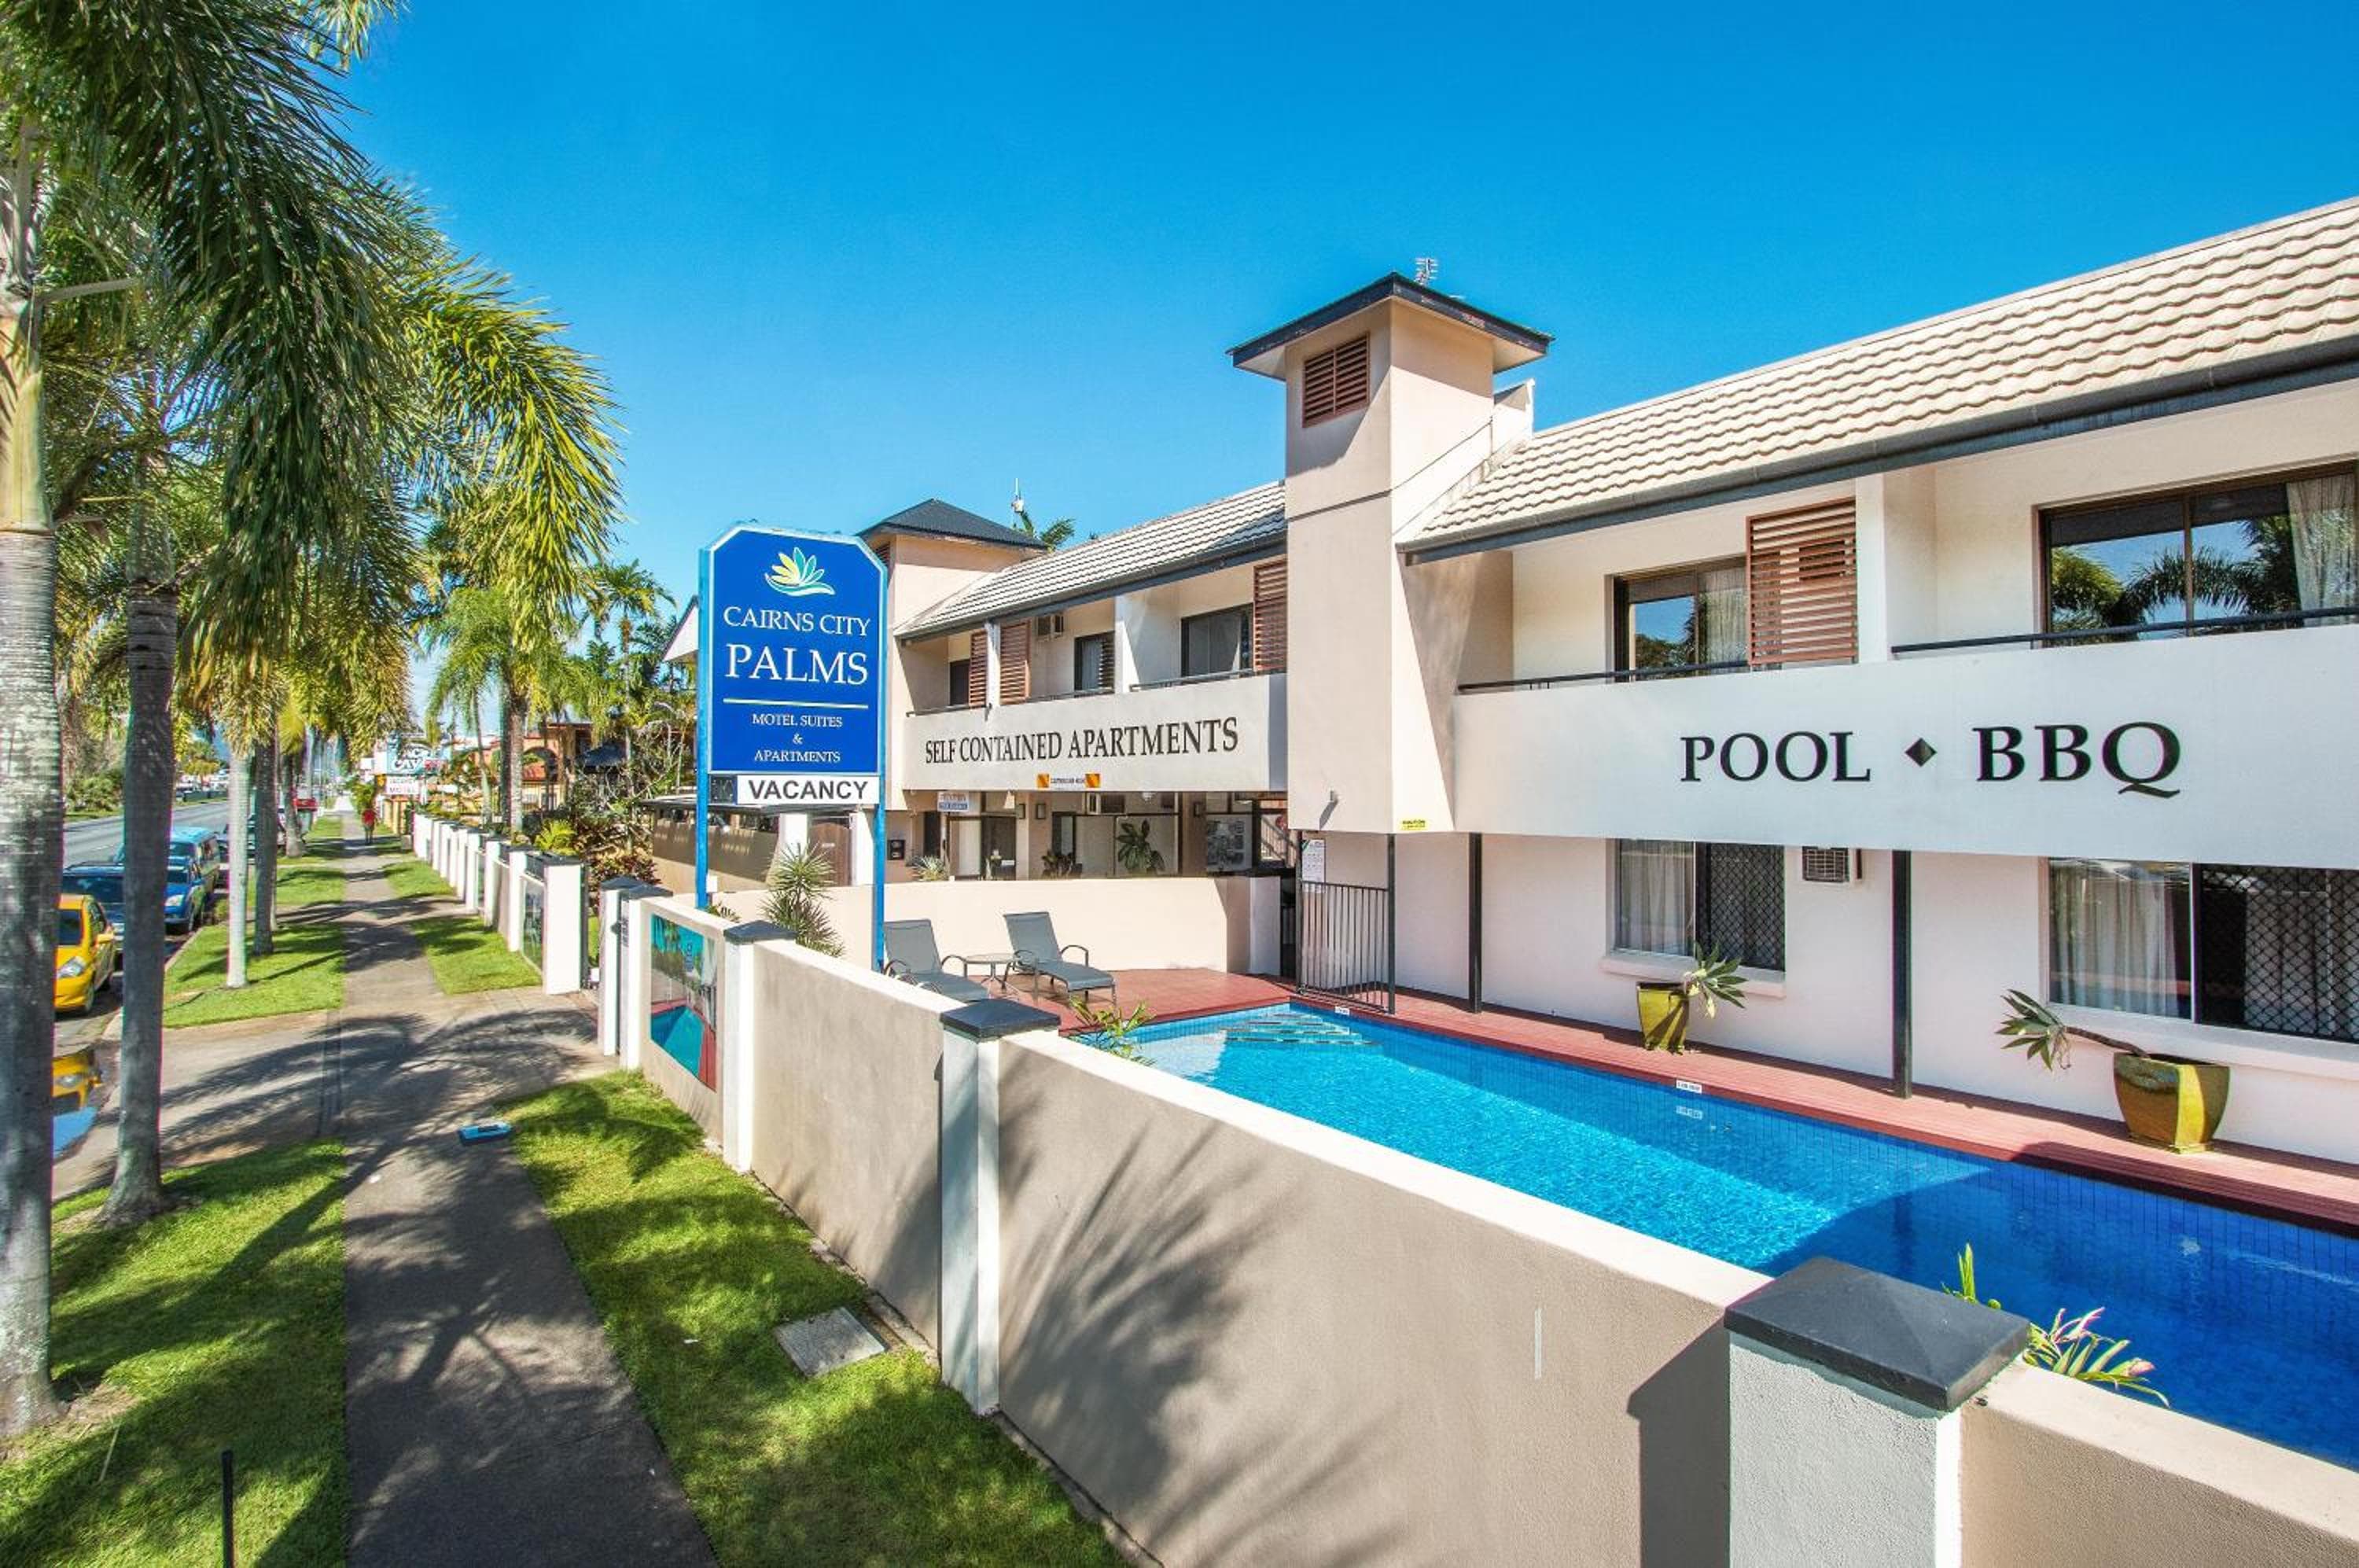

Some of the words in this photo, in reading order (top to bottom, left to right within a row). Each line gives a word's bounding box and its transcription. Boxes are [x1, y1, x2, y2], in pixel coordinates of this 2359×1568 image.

[723, 606, 814, 631] CAIRNS
[820, 614, 870, 636] CITY
[725, 643, 868, 685] PALMS
[752, 713, 797, 727] MOTEL
[800, 716, 843, 728] SUITES
[792, 733, 803, 745] &
[926, 738, 956, 764] SELF
[960, 732, 1062, 762] CONTAINED
[1068, 716, 1238, 759] APARTMENTS
[754, 750, 841, 763] APARTMENTS
[1680, 731, 1871, 782] POOL
[1972, 721, 2182, 799] BBQ
[749, 779, 868, 800] VACANCY
